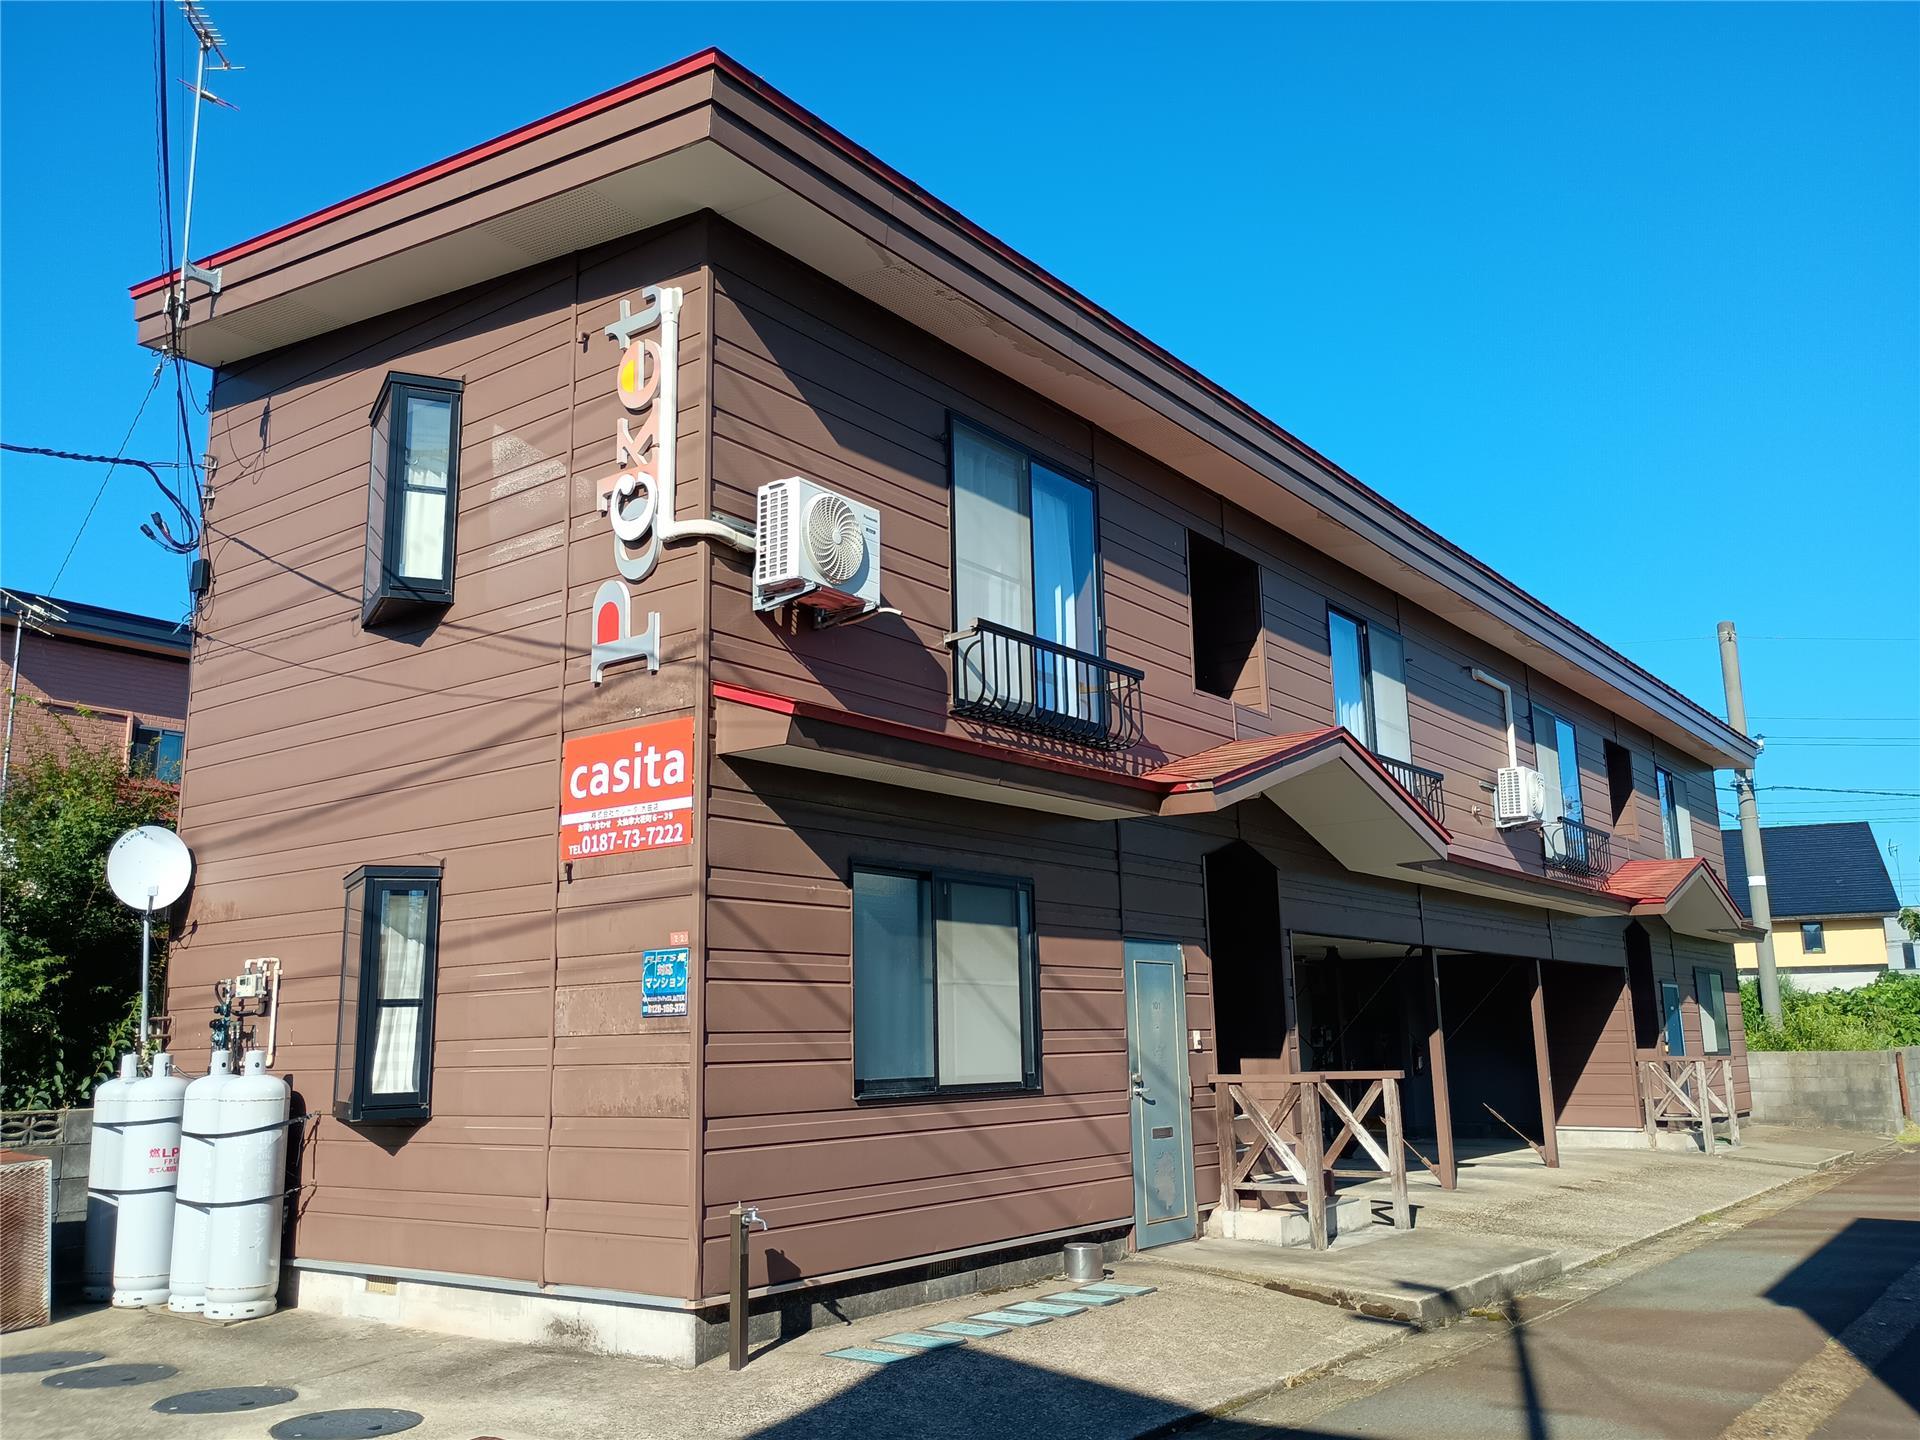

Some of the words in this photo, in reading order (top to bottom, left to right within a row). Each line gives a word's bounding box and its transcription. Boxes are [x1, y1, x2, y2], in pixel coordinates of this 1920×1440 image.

[570, 741, 685, 799] casita
[645, 976, 685, 989] マンション
